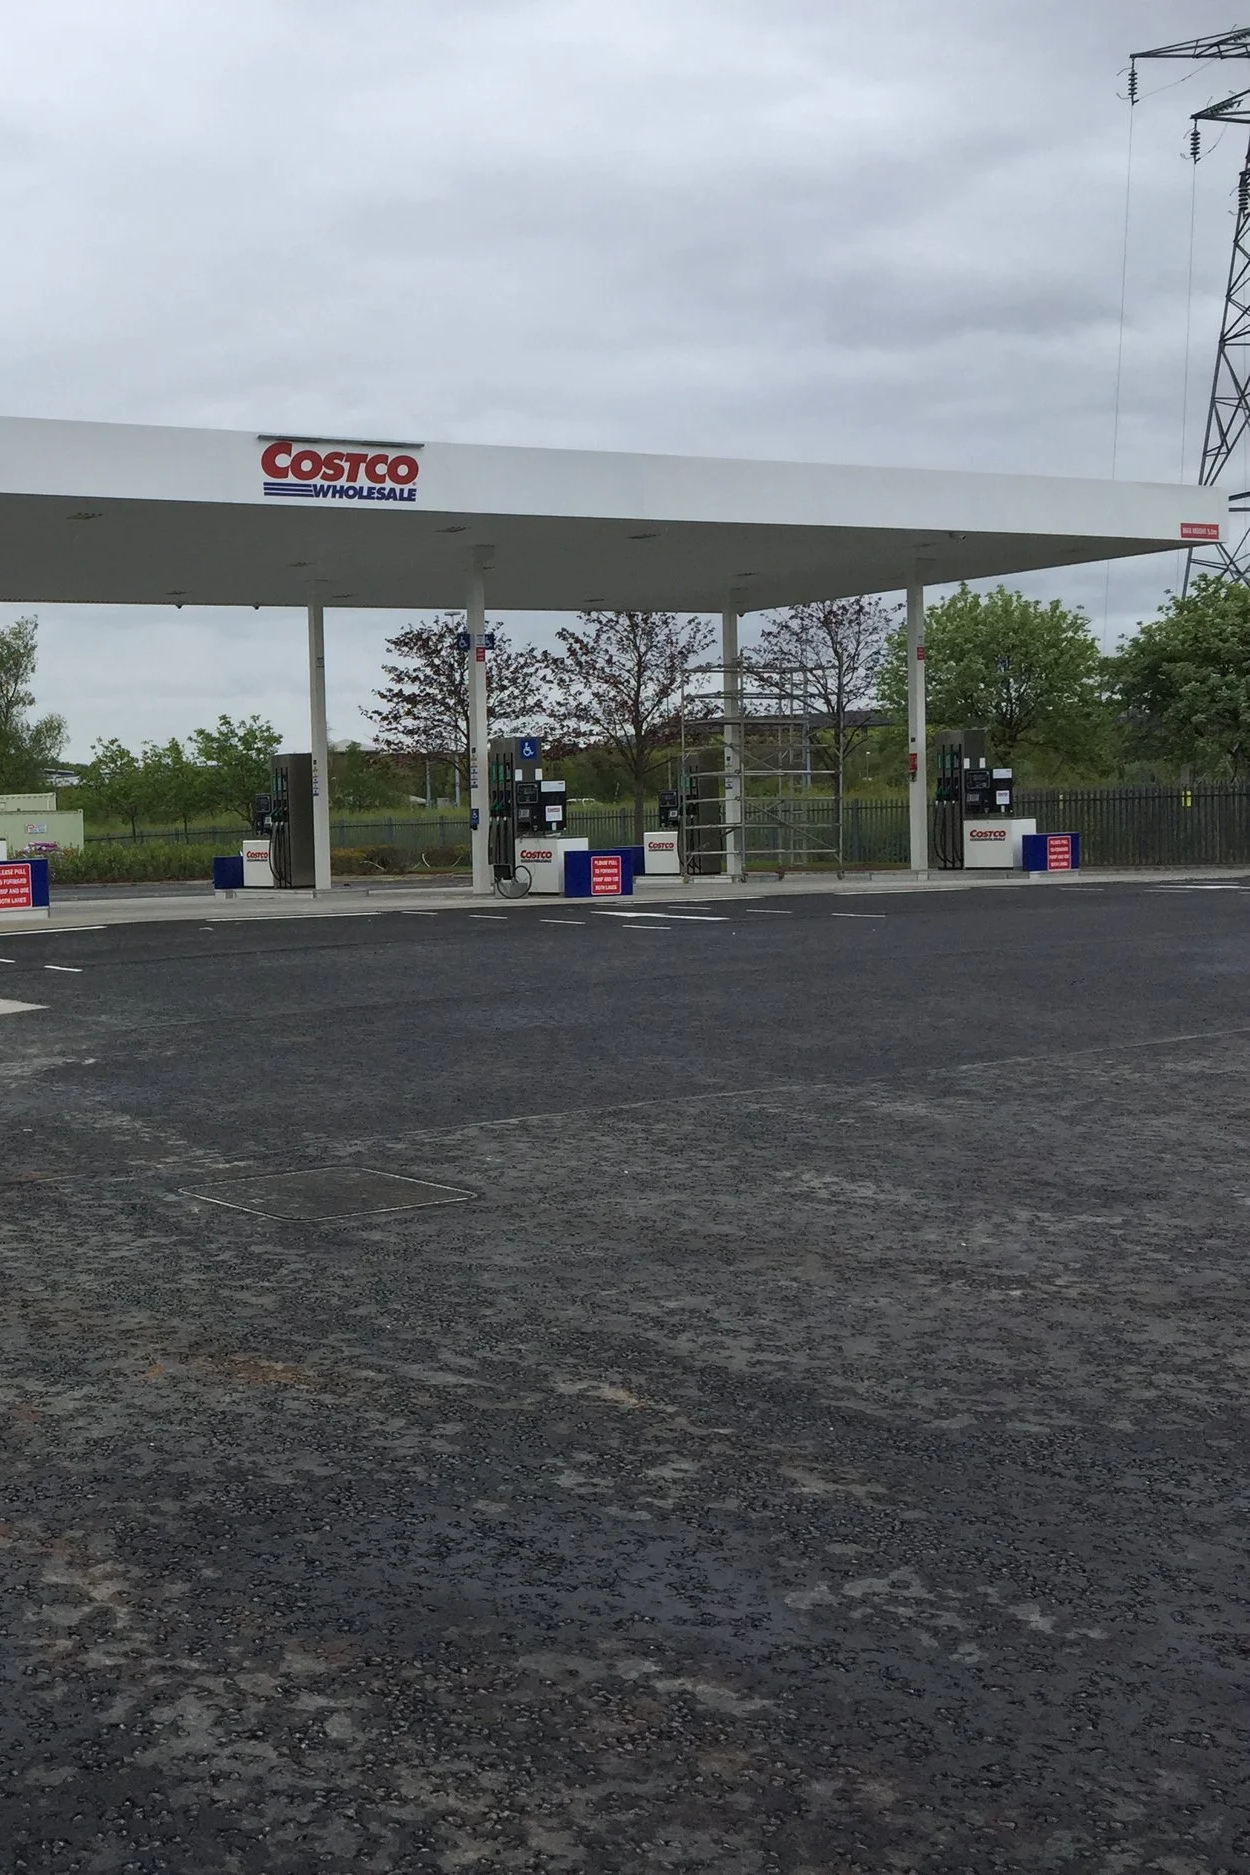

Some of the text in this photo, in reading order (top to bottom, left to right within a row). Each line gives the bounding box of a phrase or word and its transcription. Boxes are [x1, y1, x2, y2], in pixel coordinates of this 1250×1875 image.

[261, 441, 419, 485] COSTCO
[312, 484, 417, 502] WHOLESALE
[970, 829, 1006, 838] COSTCO
[520, 849, 552, 859] COSTCO
